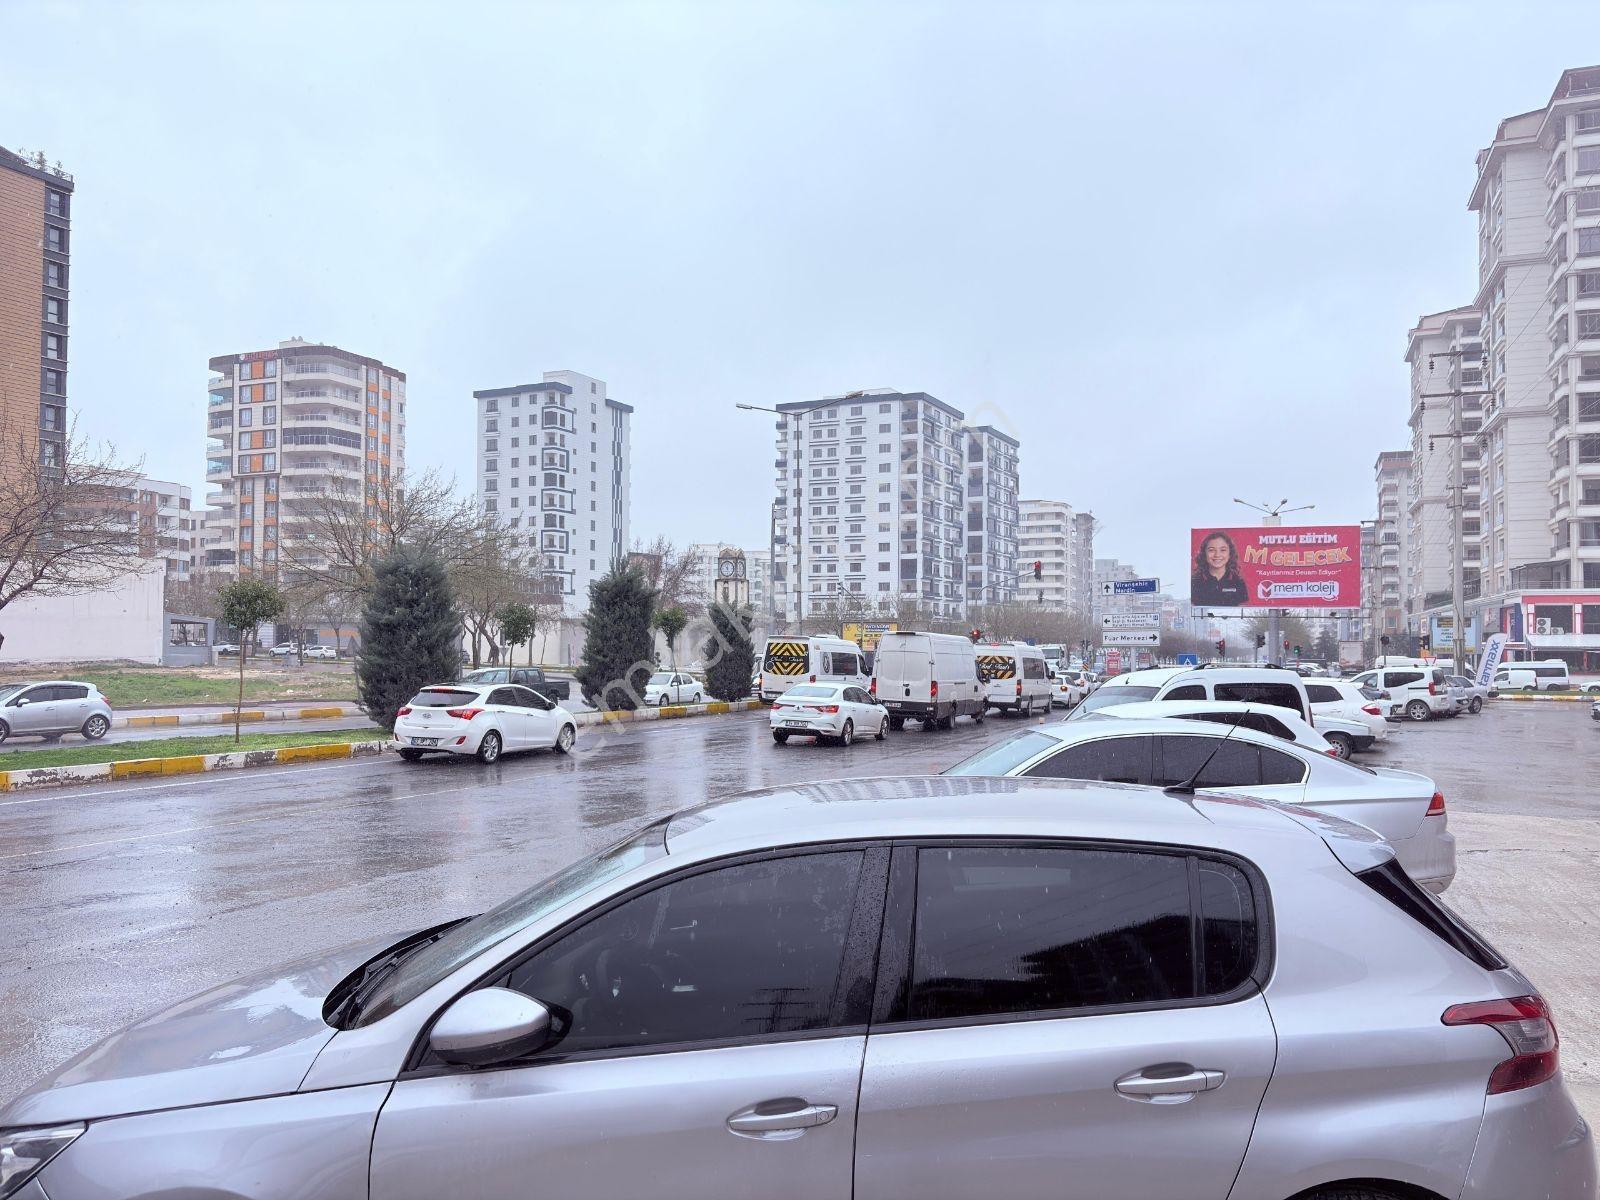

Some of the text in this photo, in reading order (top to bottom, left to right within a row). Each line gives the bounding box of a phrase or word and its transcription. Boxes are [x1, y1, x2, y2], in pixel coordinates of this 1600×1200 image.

[1259, 532, 1337, 544] MUTLU EĞİTİM
[1244, 544, 1352, 567] İYİ GELECEK
[1274, 581, 1335, 596] mem koleji
[1478, 639, 1500, 686] tarmaxx
